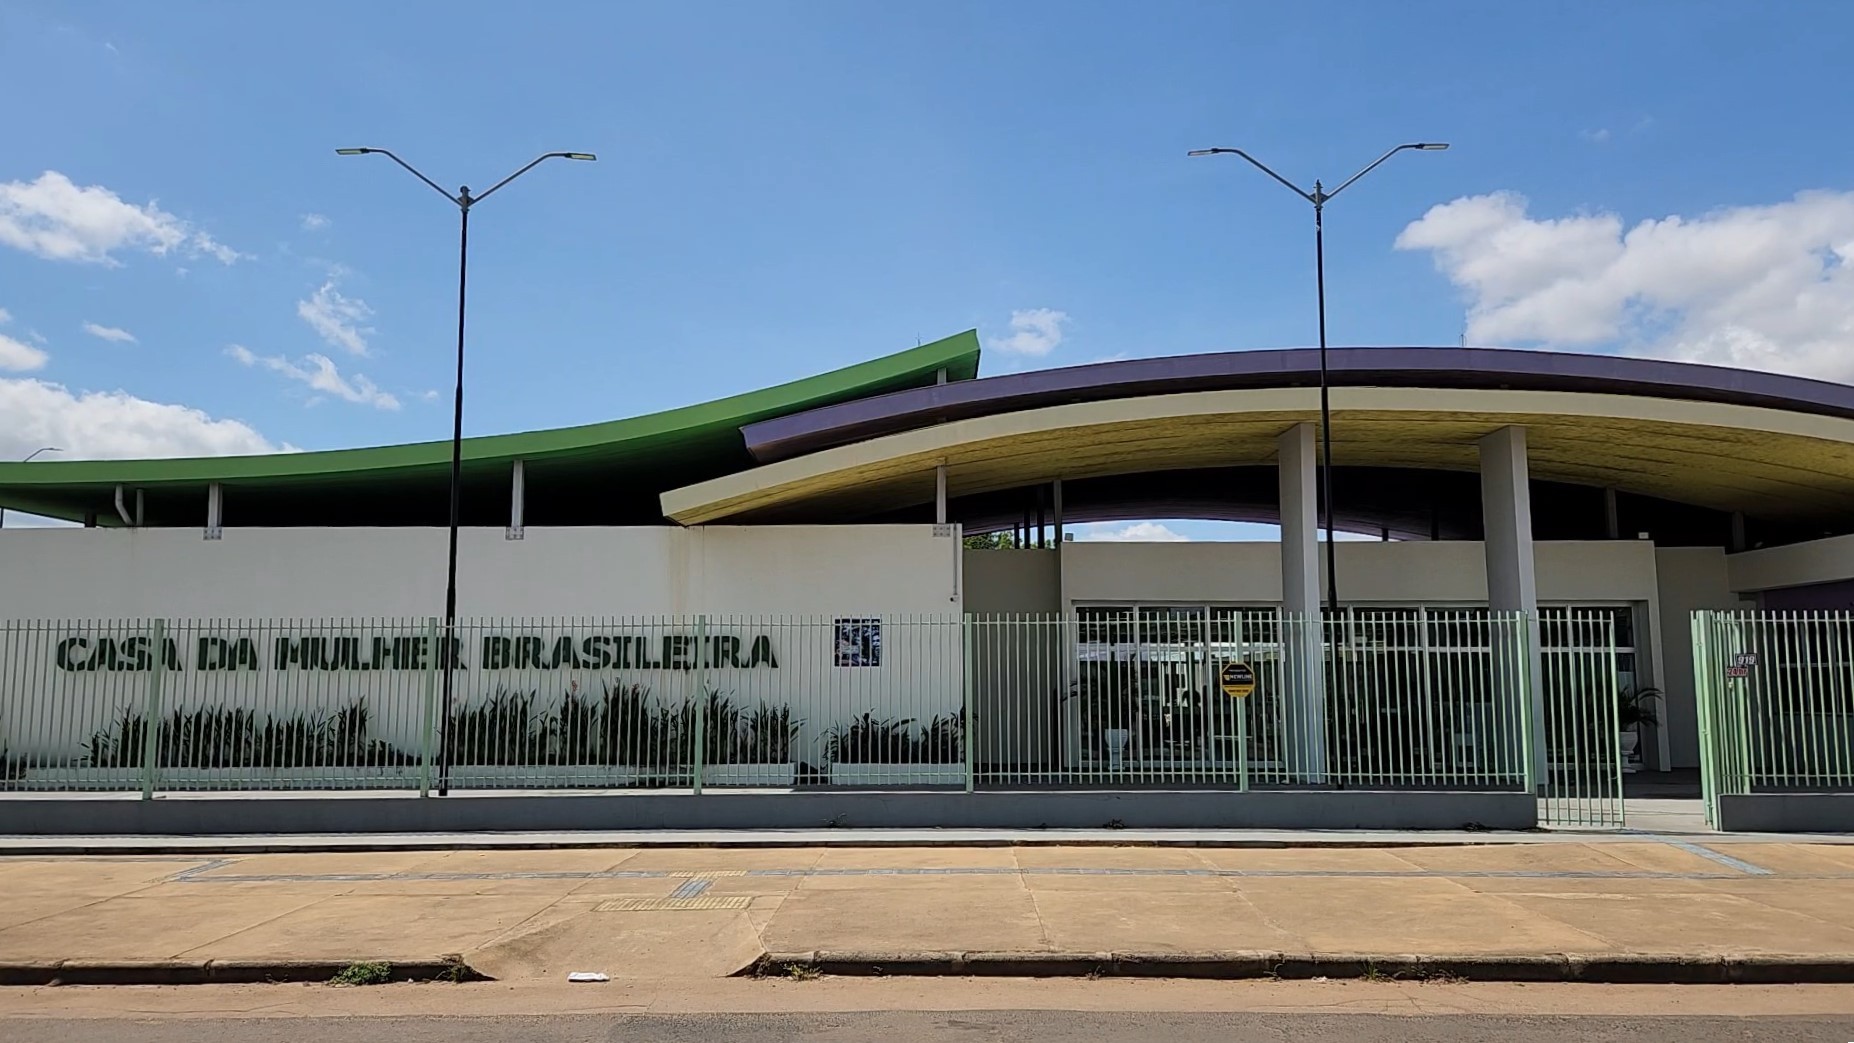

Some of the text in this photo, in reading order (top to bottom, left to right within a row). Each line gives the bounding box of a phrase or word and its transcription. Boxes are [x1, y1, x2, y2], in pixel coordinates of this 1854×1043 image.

[57, 635, 779, 672] CASA DA MULHER BRASILEIRA
[1737, 656, 1755, 665] 919
